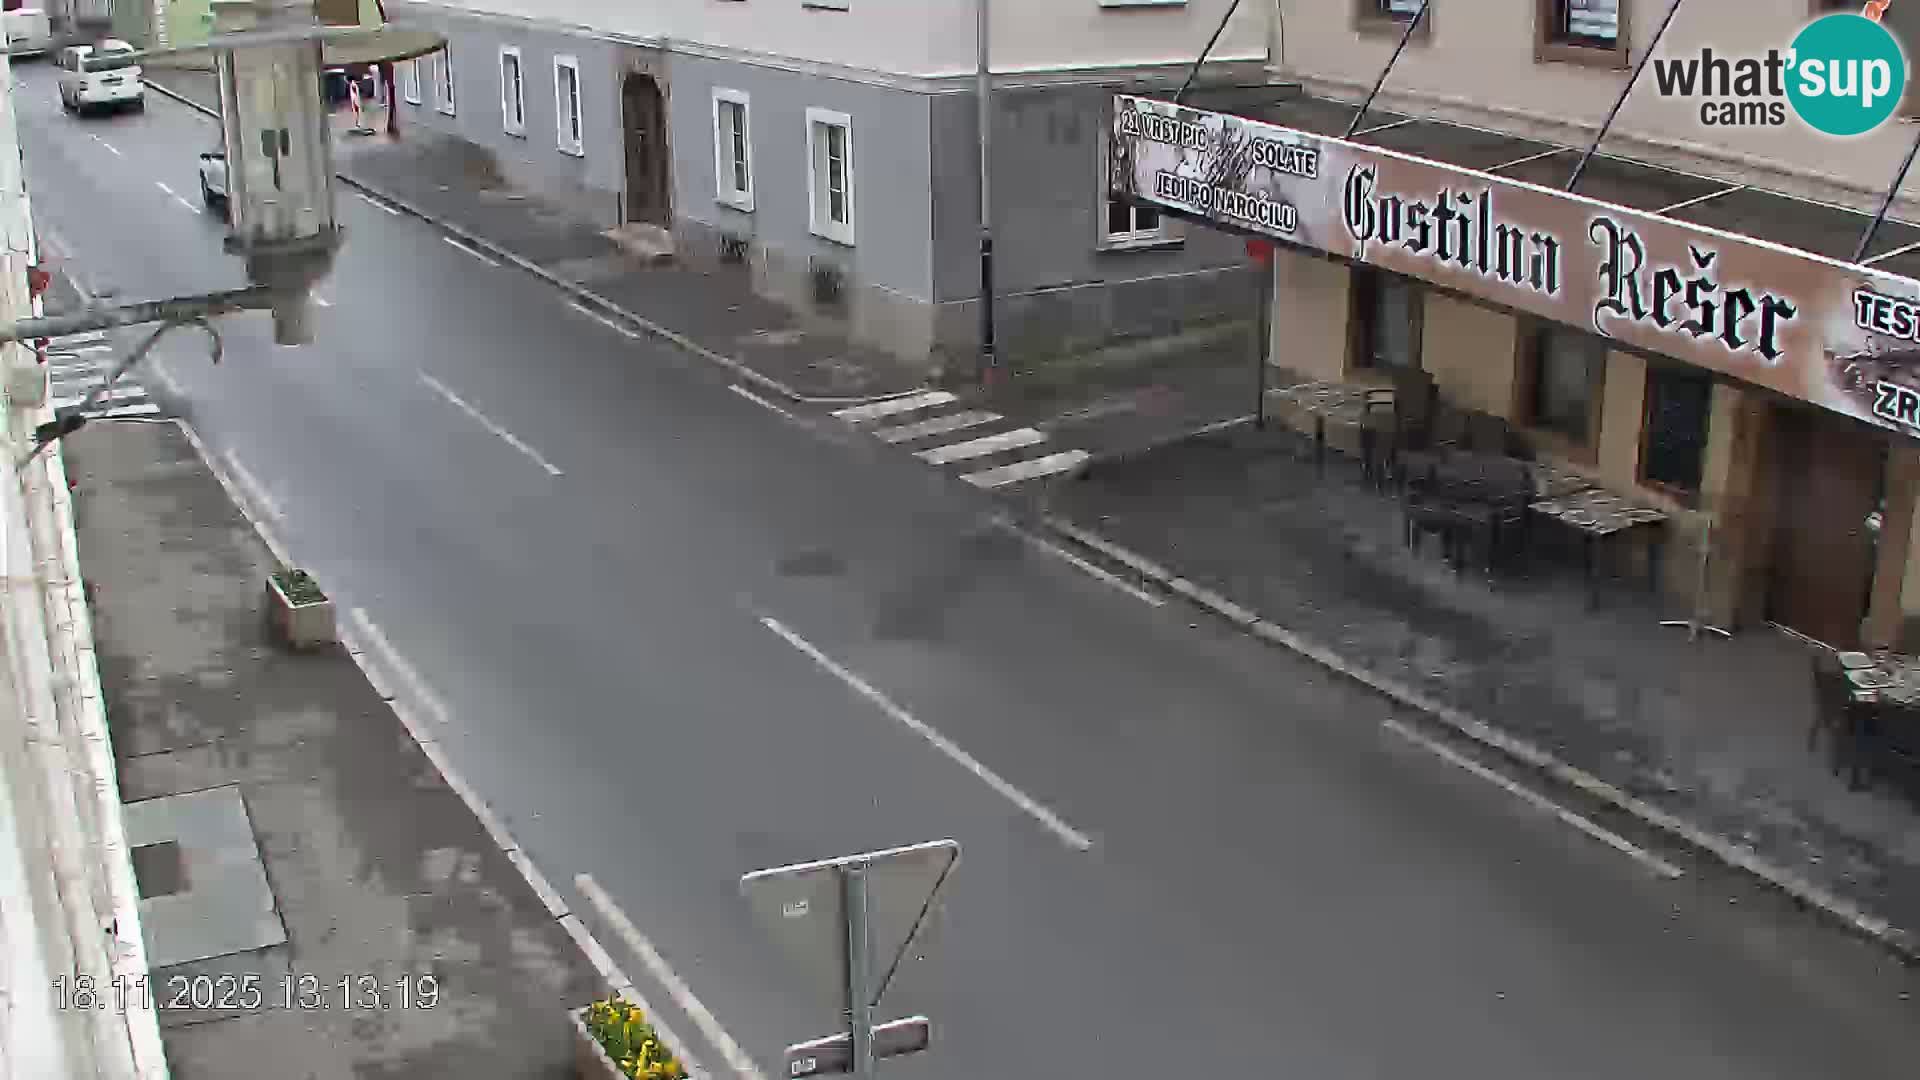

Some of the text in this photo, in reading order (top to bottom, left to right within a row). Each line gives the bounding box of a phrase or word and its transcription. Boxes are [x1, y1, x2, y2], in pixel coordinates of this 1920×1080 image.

[1252, 139, 1317, 179] SOLATE
[1152, 171, 1187, 202] JEDI
[1187, 179, 1212, 209] PO
[1343, 162, 1798, 364] Gostilna Rešer
